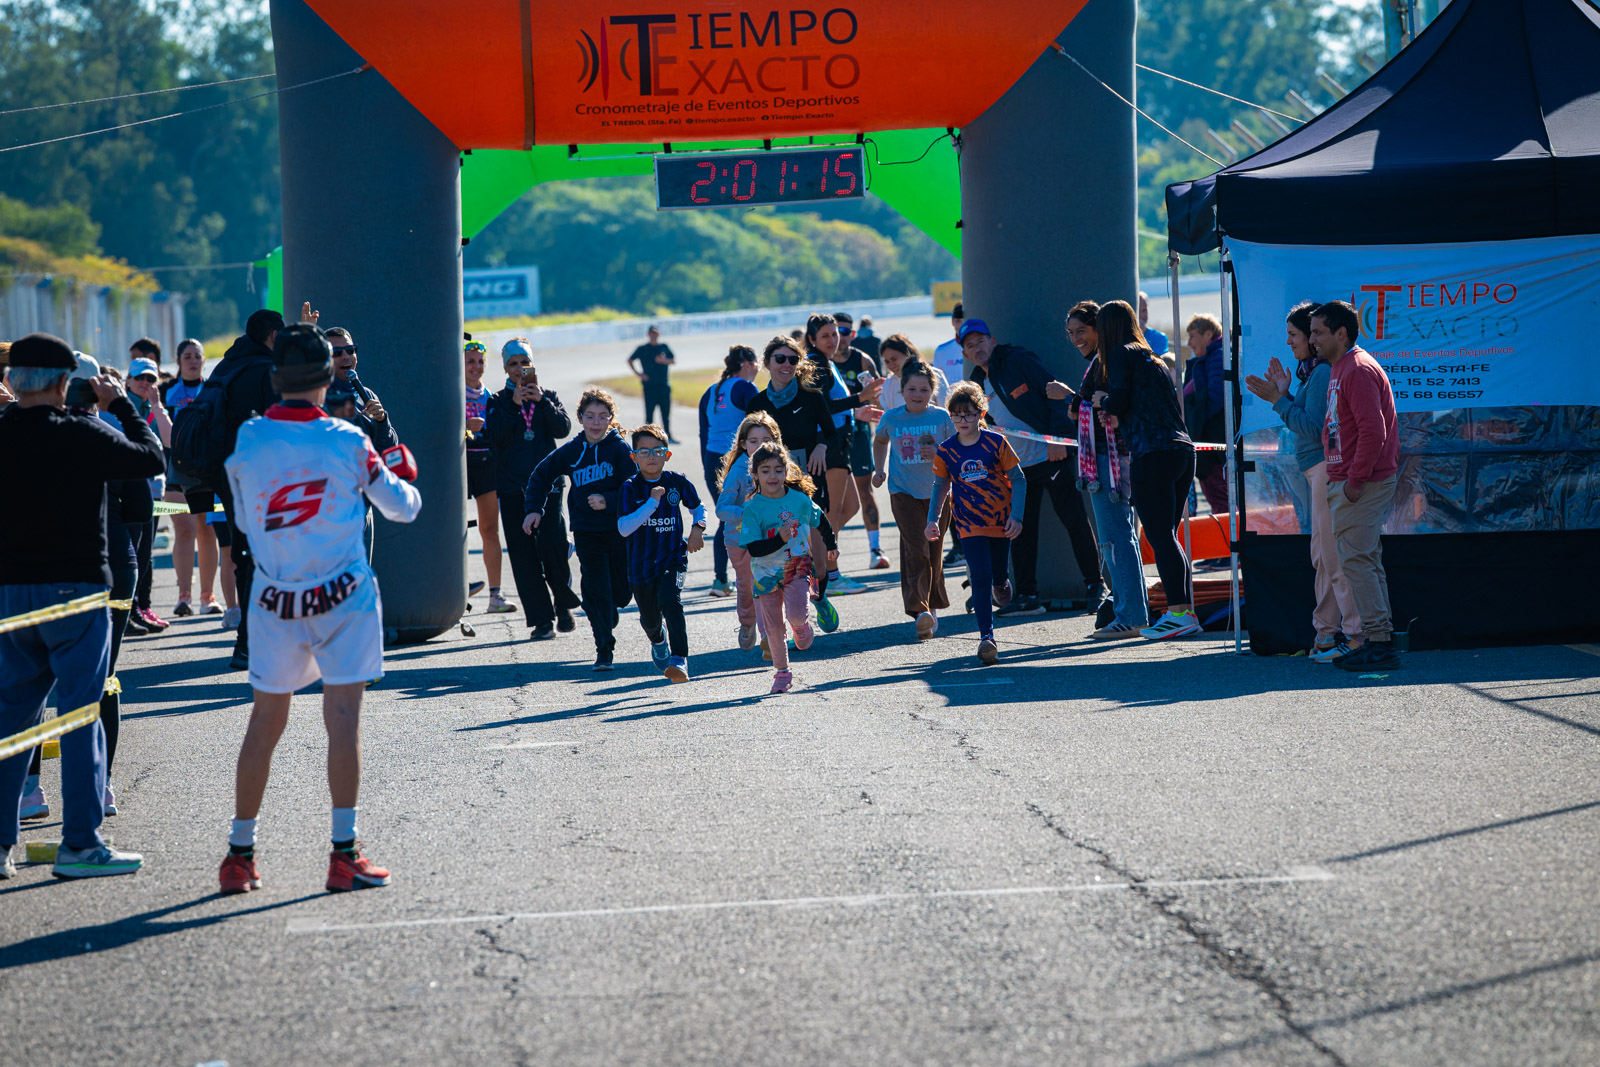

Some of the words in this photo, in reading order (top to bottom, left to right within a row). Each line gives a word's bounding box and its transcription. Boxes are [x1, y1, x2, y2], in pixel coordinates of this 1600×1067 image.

[575, 101, 680, 115] Cronometraje
[684, 100, 703, 112] de
[708, 99, 769, 111] Eventos
[773, 95, 860, 110] Deportivos
[771, 113, 804, 121] Tiempo
[691, 153, 857, 204] 2:01:15
[1398, 349, 1411, 359] de
[1414, 348, 1456, 359] Eventos
[1459, 345, 1515, 359] Deportivos
[1382, 362, 1491, 374] RÉBOL-STA-FE
[1407, 378, 1422, 386] 15
[1426, 378, 1445, 386] 52
[1448, 377, 1481, 386] 7413
[1394, 391, 1409, 399] 15
[1413, 390, 1433, 399] 68
[1437, 390, 1484, 399] 66557
